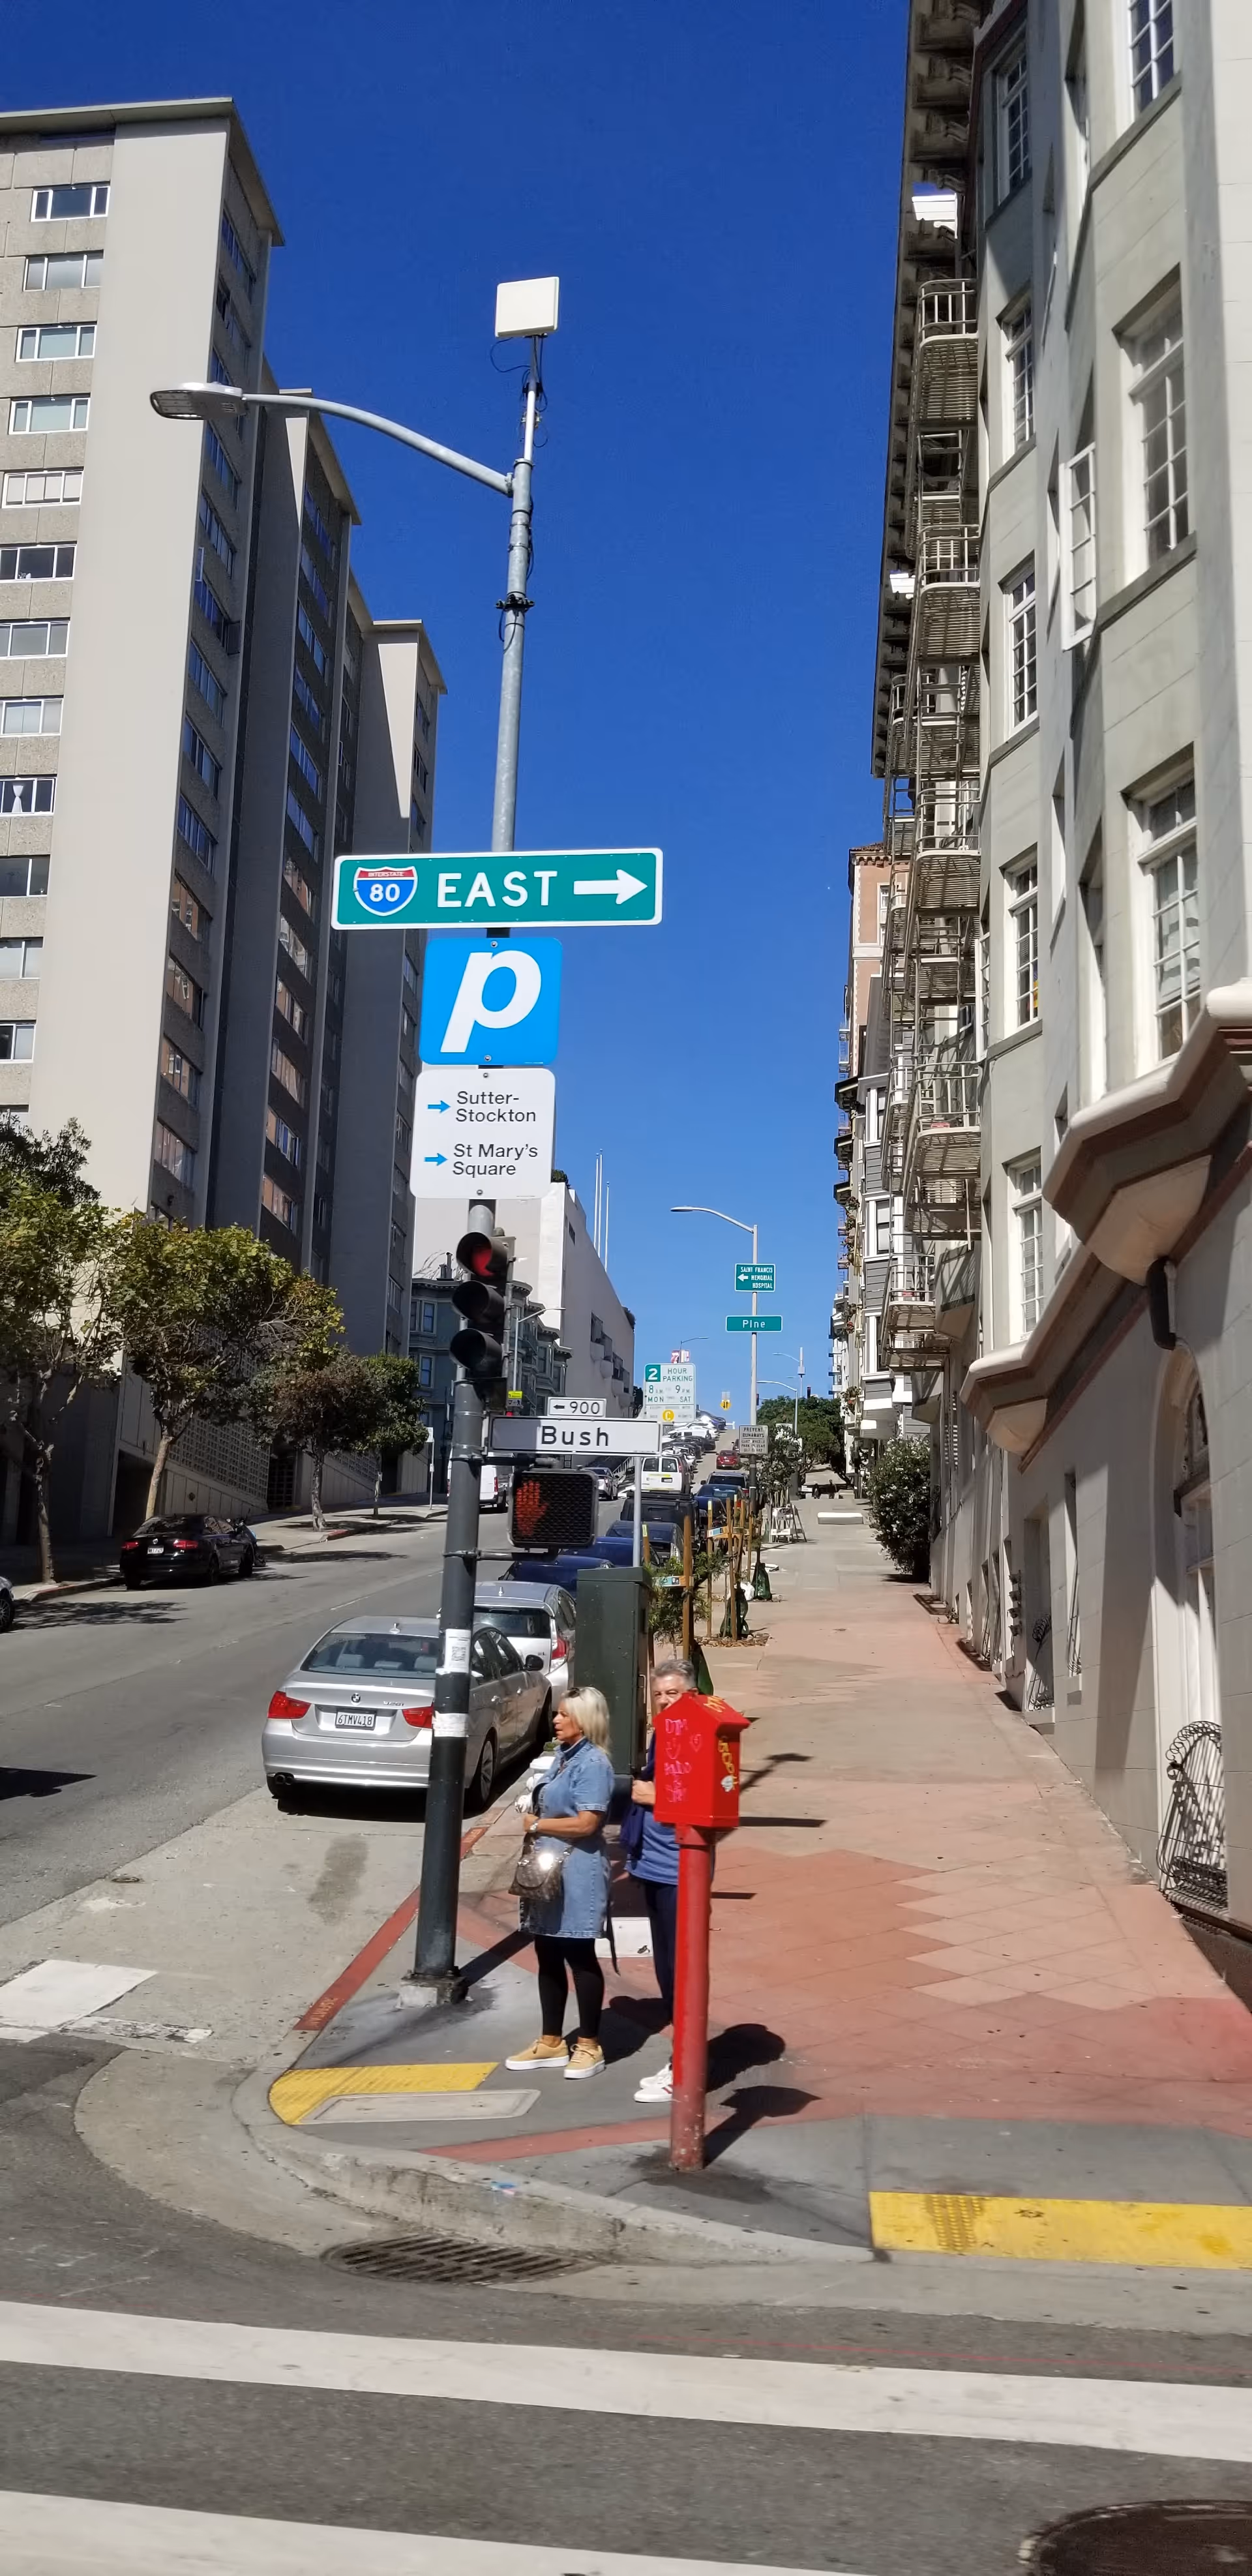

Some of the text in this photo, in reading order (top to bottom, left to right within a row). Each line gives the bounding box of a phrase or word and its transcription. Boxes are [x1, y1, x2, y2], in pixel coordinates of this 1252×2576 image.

[369, 871, 558, 908] 80 EAST
[456, 1090, 520, 1105] Sutter-
[455, 1108, 537, 1122] Stockton
[453, 1143, 539, 1161] St Mary's
[452, 1161, 516, 1178] Square
[648, 1367, 658, 1381] 2
[648, 1385, 654, 1394] 8
[675, 1385, 681, 1394] 9
[569, 1401, 600, 1415] 900
[541, 1425, 609, 1446] Bush
[338, 1714, 373, 1726] 6TMV418
